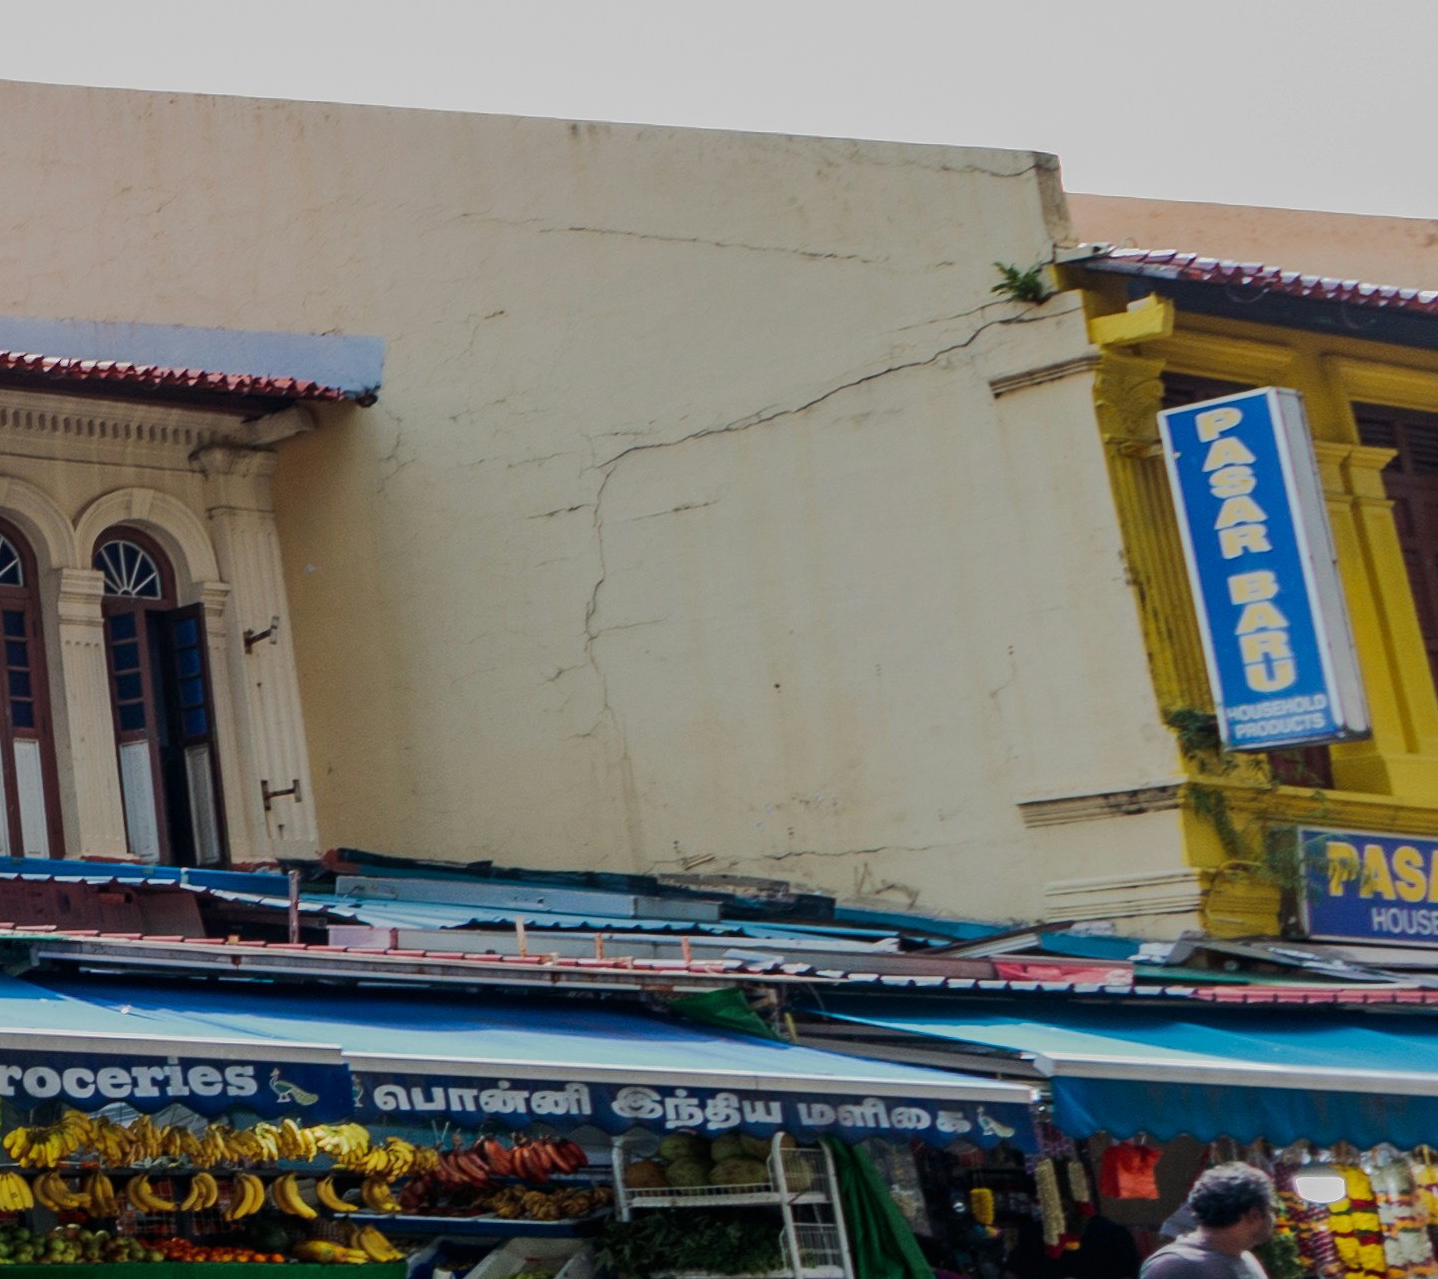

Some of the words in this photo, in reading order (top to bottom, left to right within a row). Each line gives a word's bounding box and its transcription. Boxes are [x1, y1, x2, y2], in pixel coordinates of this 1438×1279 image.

[1195, 407, 1274, 560] PASAR
[1227, 570, 1296, 693] BARU
[1226, 693, 1326, 721] HOUSEHOLD
[1235, 712, 1325, 739] PRODUCTS
[1326, 841, 1438, 904] PAS
[373, 1080, 593, 1118] பொன்னி
[611, 1085, 783, 1131] இந்திய
[797, 1098, 972, 1134] மளிகை
